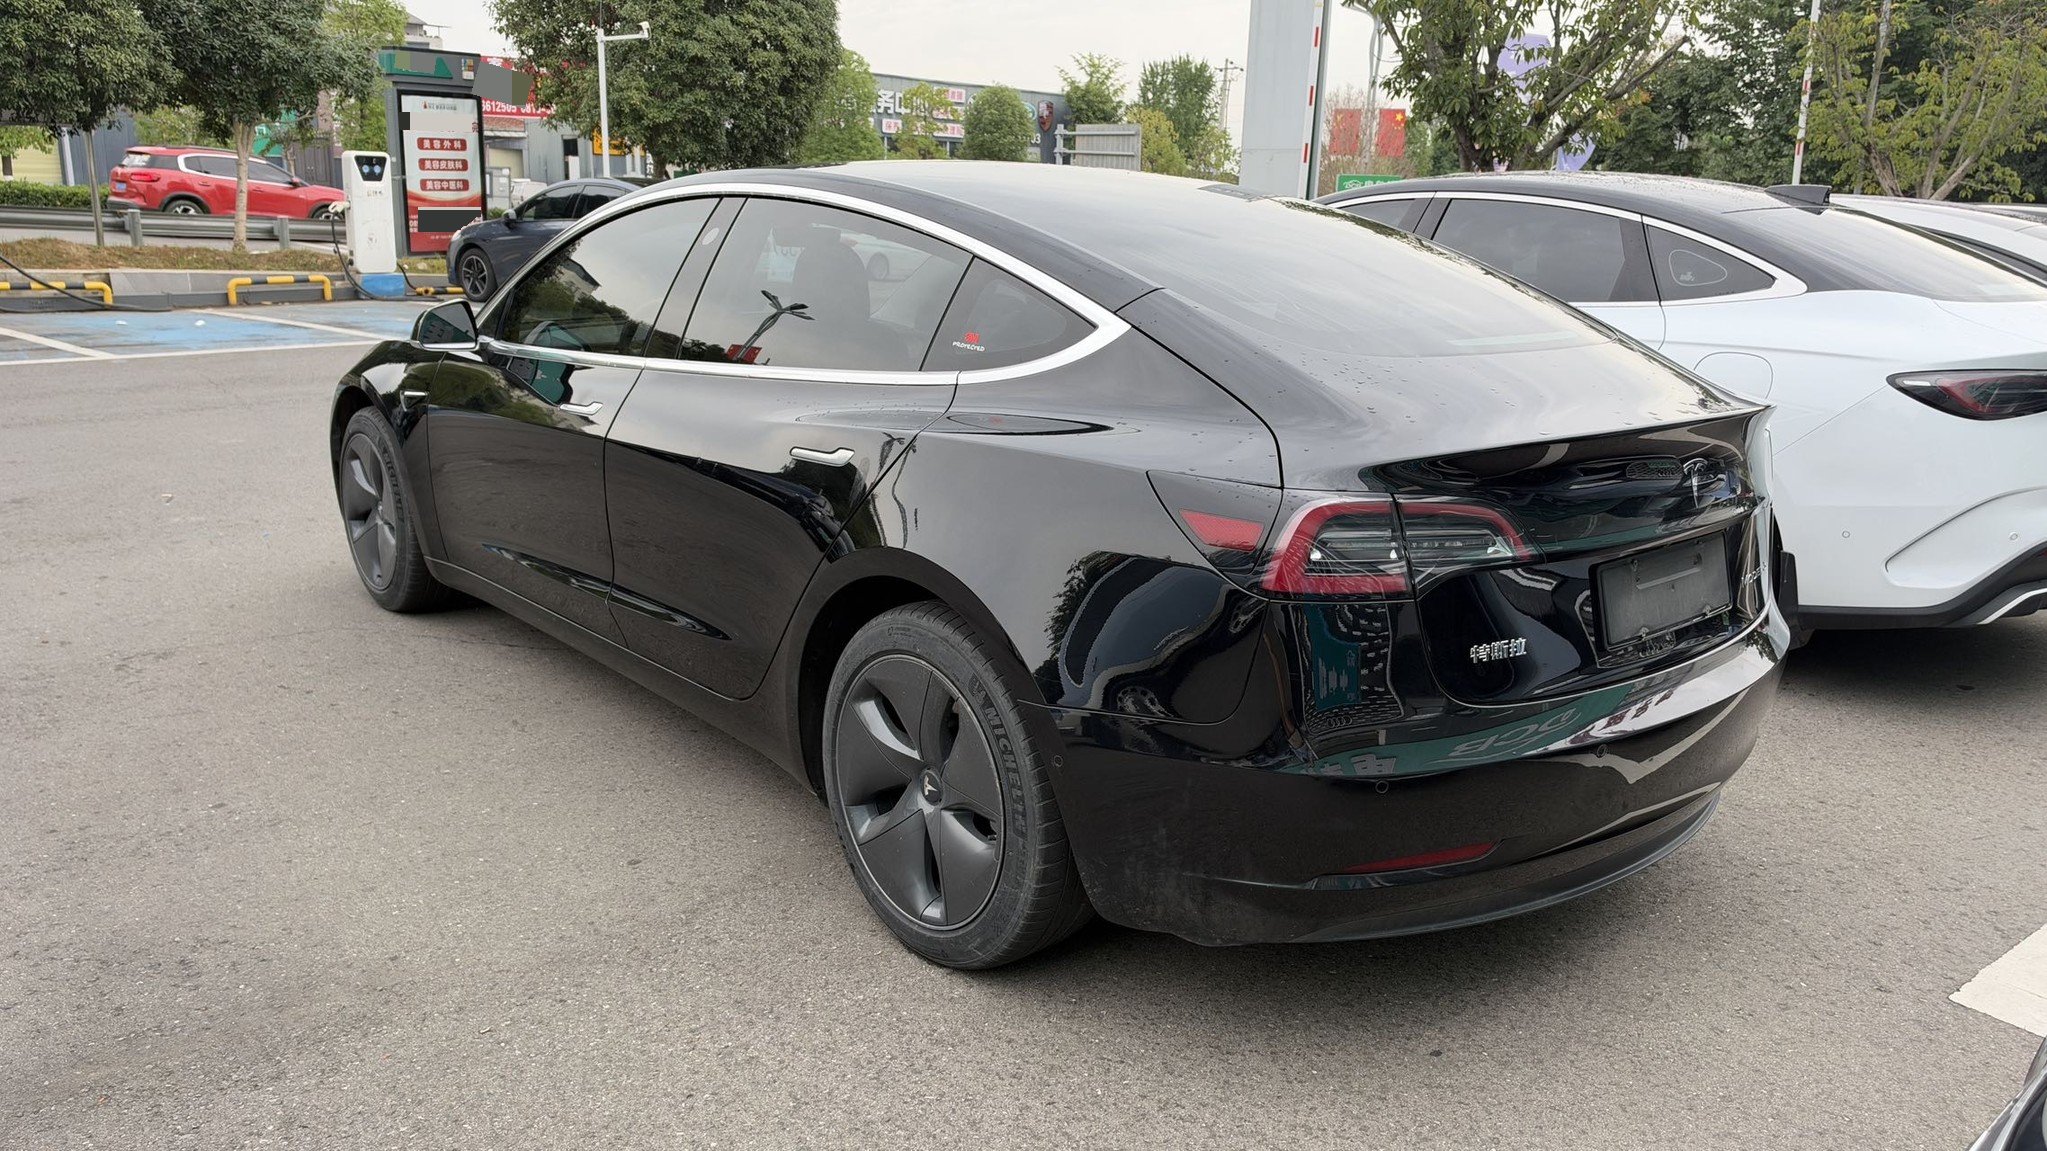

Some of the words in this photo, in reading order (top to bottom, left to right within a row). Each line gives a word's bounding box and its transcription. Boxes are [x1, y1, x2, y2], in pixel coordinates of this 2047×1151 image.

[423, 139, 462, 149] 美容外科
[424, 160, 463, 170] 美容皮肤科
[426, 180, 464, 190] 美容中医科
[1469, 637, 1528, 664] 特斯拉
[984, 704, 1028, 838] MICHELIN
